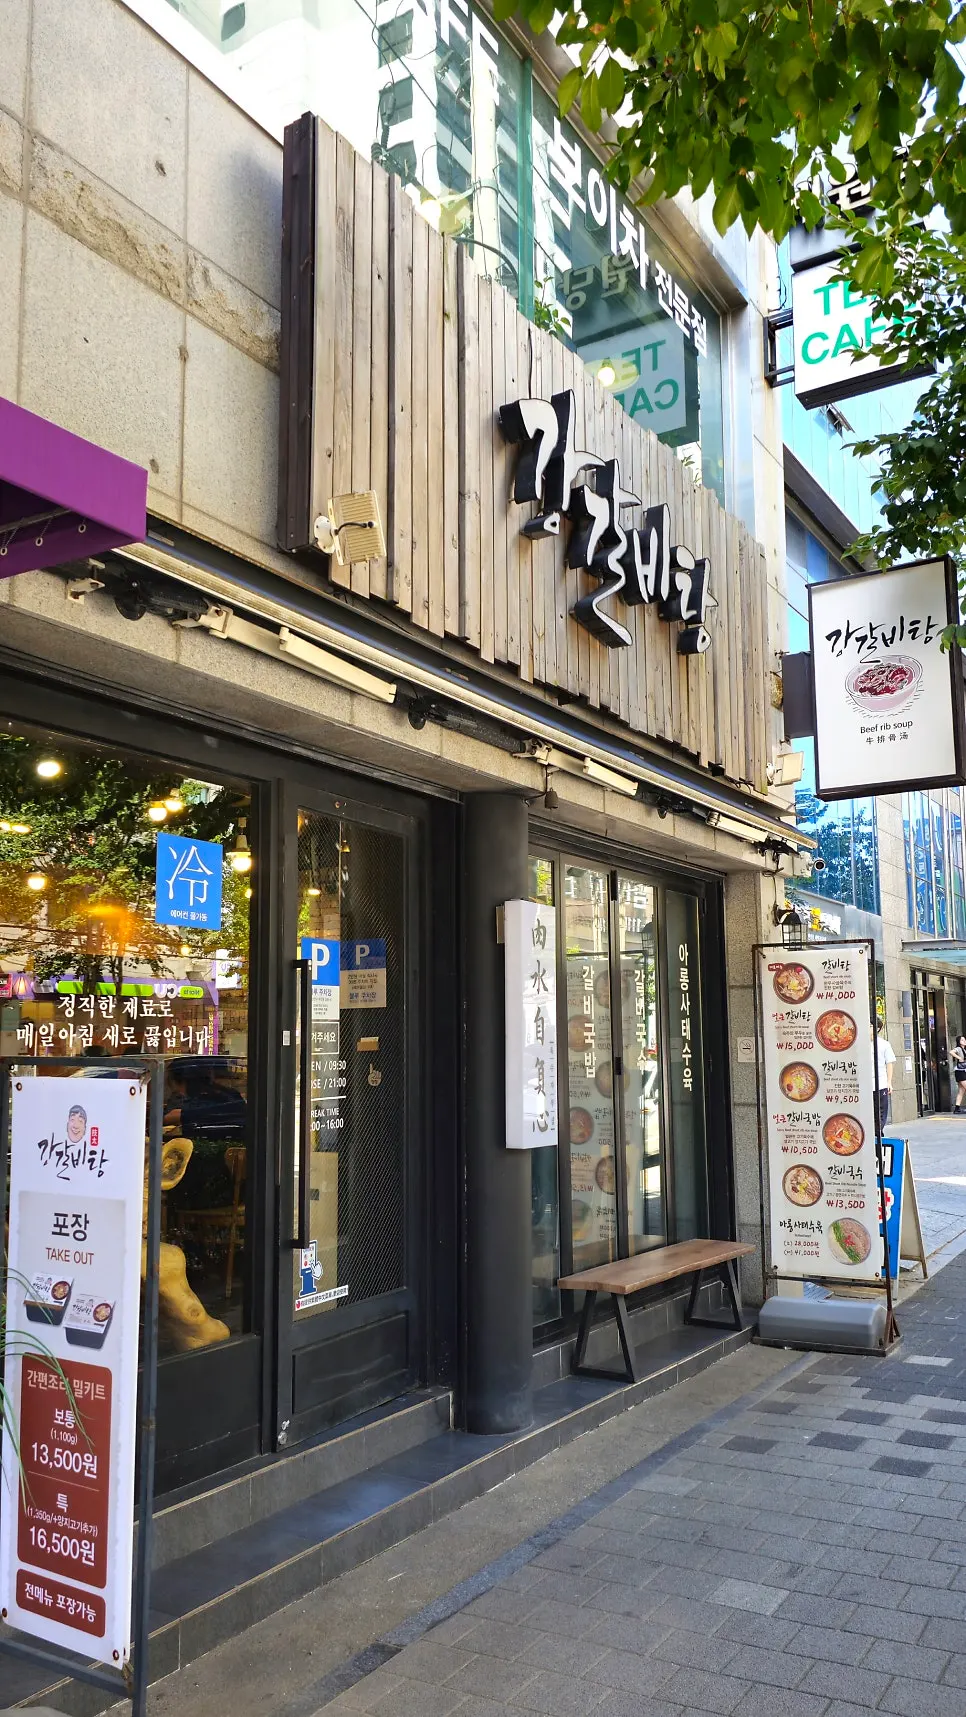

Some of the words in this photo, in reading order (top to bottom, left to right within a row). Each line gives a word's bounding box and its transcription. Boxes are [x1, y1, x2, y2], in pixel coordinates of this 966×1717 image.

[655, 259, 708, 359] 전문점
[499, 388, 719, 652] 강갈비탕
[825, 615, 945, 664] 강갈비탕
[860, 723, 879, 735] Beef
[880, 721, 892, 731] rib
[893, 718, 914, 731] soup
[165, 845, 214, 907] 冷
[170, 909, 189, 920] 에어컨
[311, 942, 331, 981] P
[355, 943, 370, 966] P
[821, 958, 851, 975] 갈비탕
[57, 993, 117, 1019] 정직한
[122, 996, 175, 1020] 재료로
[815, 991, 856, 1001] ₩14,000
[582, 965, 597, 1079] 갈비국밥
[634, 969, 648, 1076] 갈비국수
[678, 943, 693, 1092] 아롱사태수육
[102, 1023, 139, 1049] 새로
[143, 1025, 211, 1049] 끓입니다
[776, 1041, 814, 1051] ₩15,000
[311, 1060, 322, 1072] EN
[328, 1060, 347, 1071] 09:30
[821, 1060, 858, 1077] 갈비국밥
[311, 1078, 322, 1090] SE
[328, 1077, 347, 1088] 21:00
[825, 1095, 860, 1104] ₩9,500
[311, 1108, 325, 1118] REAK
[326, 1107, 340, 1116] TIME
[38, 1132, 110, 1181] 강갈비탕
[781, 1145, 818, 1155] ₩10,500
[827, 1164, 863, 1180] 갈비국수
[826, 1199, 865, 1210] ₩13,500
[51, 1212, 90, 1242] 포장
[779, 1218, 823, 1234] 아롱사태수육
[45, 1247, 71, 1263] TAKE
[73, 1250, 95, 1266] OUT
[73, 1379, 106, 1401] 밀키트
[53, 1408, 76, 1429] 보통
[31, 1441, 98, 1479] 13,500원
[56, 1493, 69, 1513] 특
[29, 1525, 96, 1567] 16,500원
[24, 1582, 54, 1607] 전메뉴
[55, 1593, 97, 1623] 포장가능
